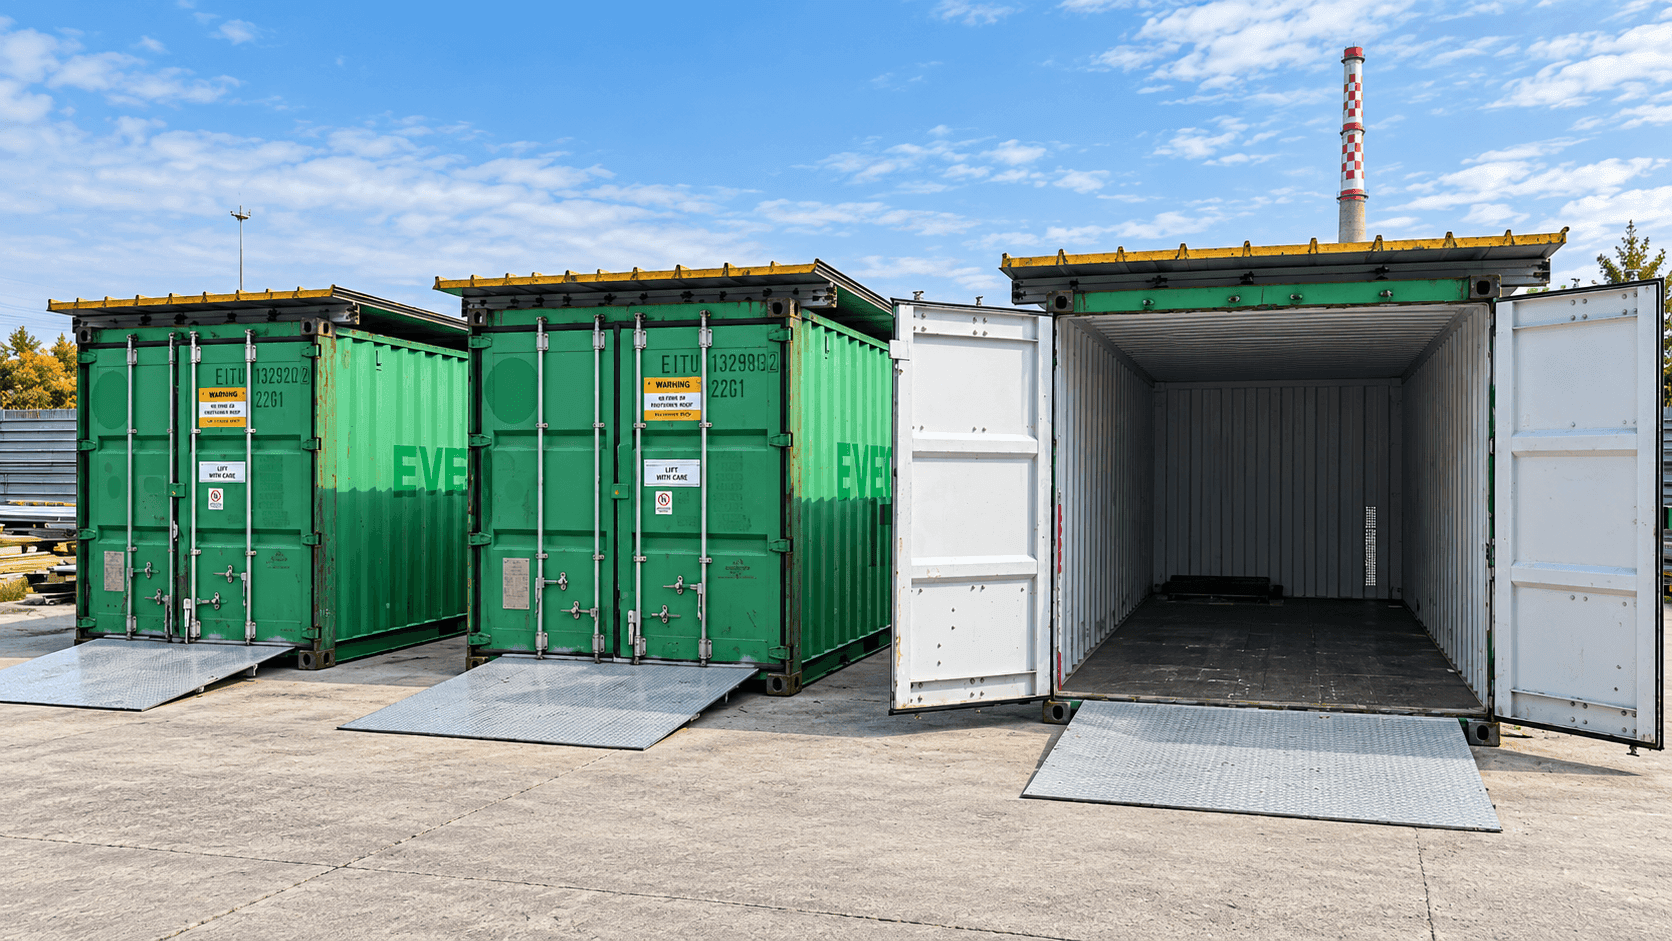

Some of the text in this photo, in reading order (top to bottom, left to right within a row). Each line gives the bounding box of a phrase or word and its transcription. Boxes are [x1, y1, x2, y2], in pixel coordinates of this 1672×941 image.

[662, 354, 699, 374] EITU
[215, 368, 245, 385] EITU
[711, 379, 744, 398] 22G1
[256, 391, 283, 408] 22G1
[394, 445, 468, 497] EVE
